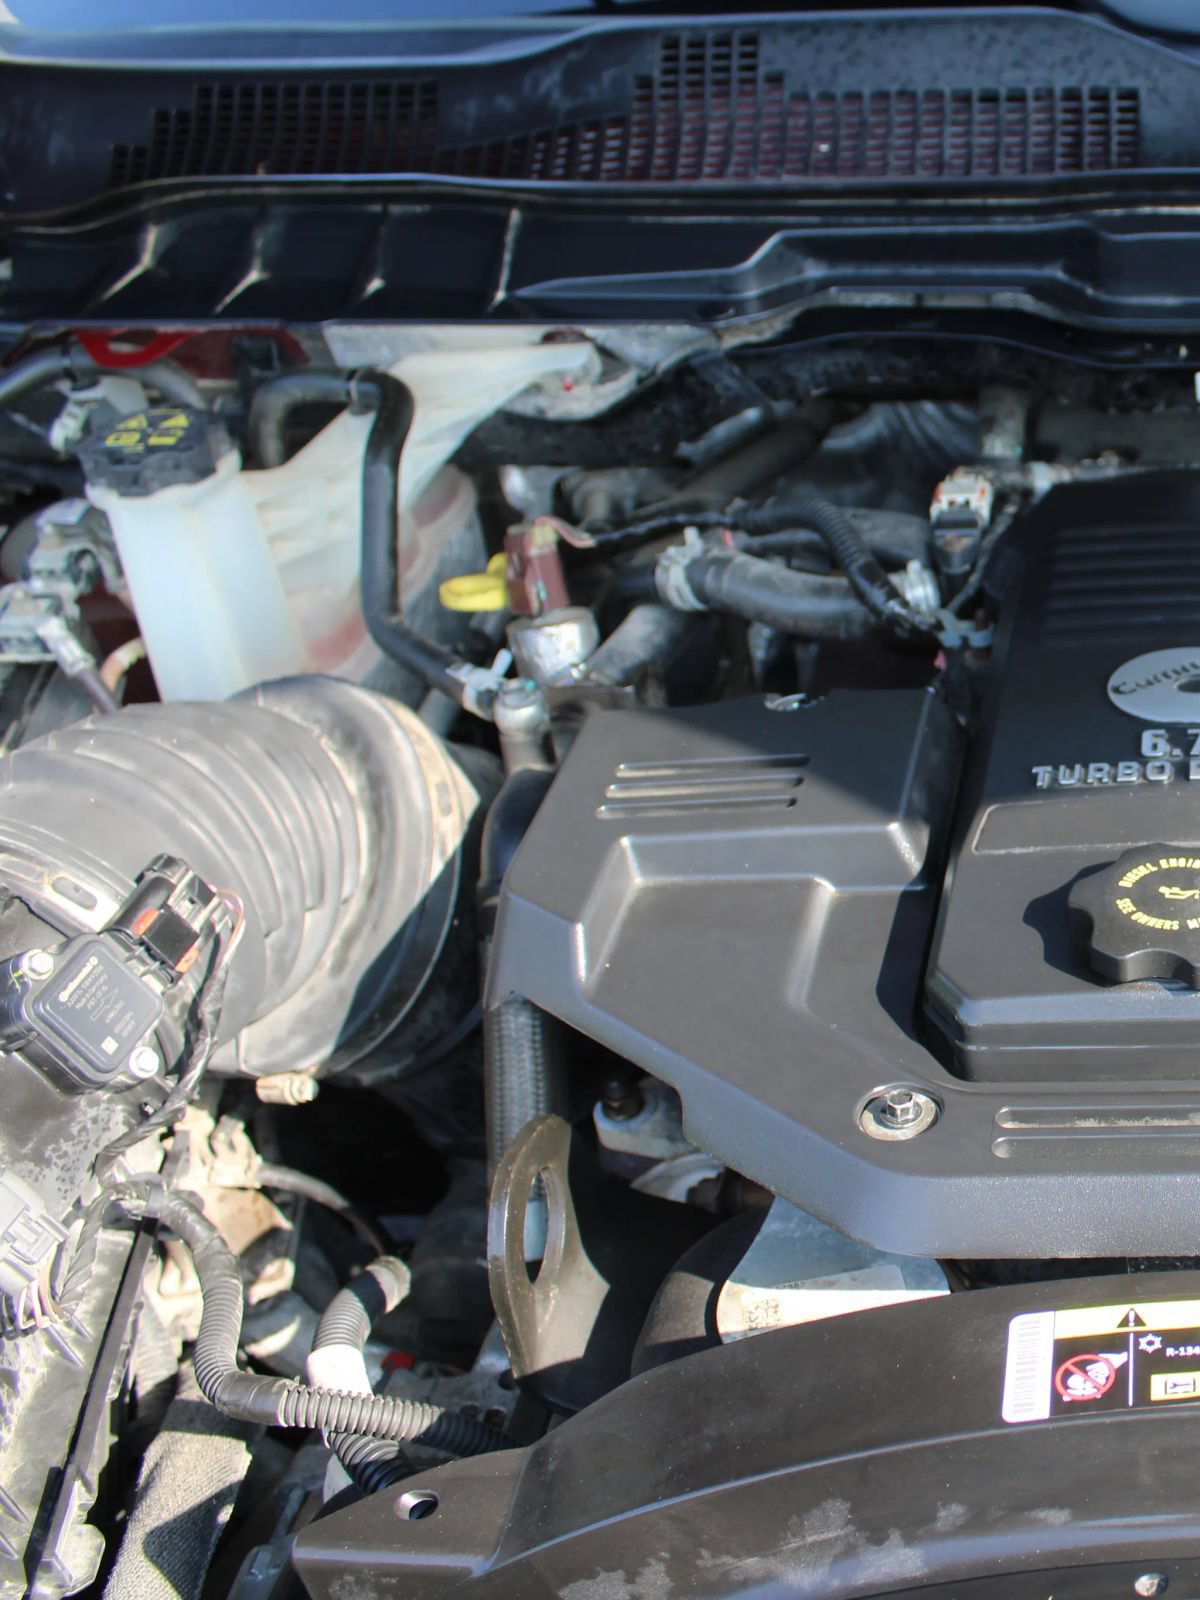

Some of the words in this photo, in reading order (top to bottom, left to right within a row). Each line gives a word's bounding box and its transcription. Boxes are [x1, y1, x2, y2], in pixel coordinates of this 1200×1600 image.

[1032, 759, 1174, 788] TURBO
[1118, 862, 1159, 888] DIESEL
[1115, 897, 1137, 915] SEE
